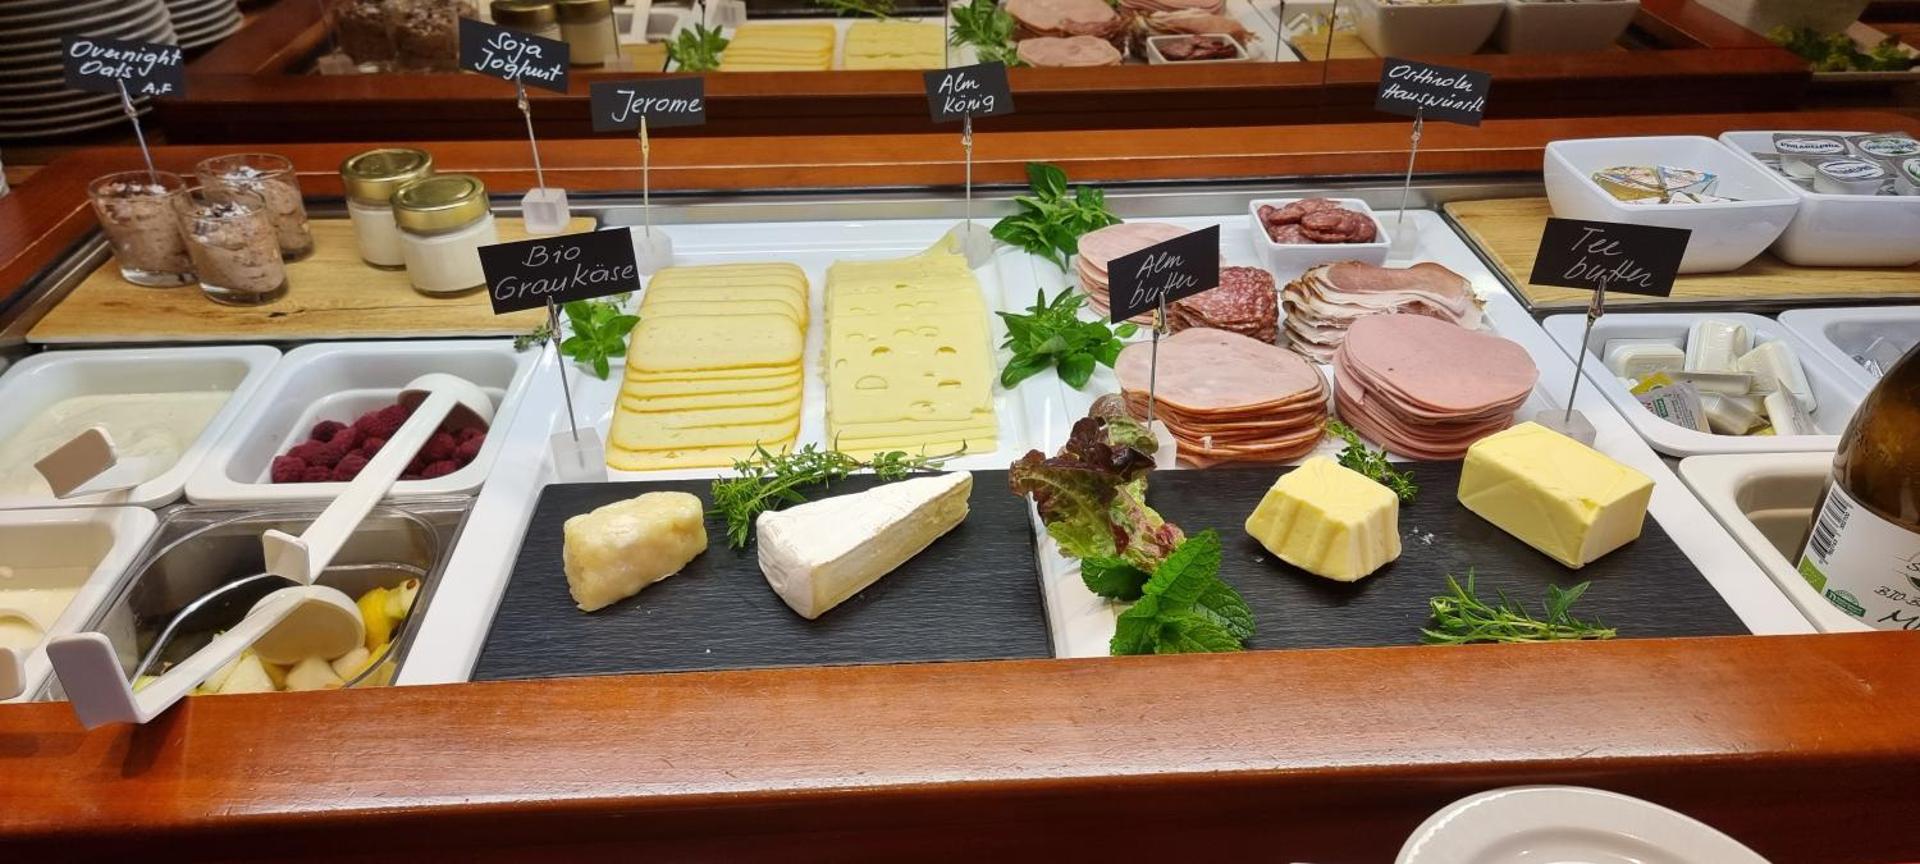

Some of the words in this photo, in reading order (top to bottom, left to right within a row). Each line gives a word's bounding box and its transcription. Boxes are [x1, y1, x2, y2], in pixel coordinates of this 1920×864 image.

[70, 41, 182, 76] Overnight
[488, 32, 542, 63] Soja
[79, 60, 134, 79] Oats
[474, 48, 563, 81] Joghurt
[1388, 65, 1473, 92] Osttiroler
[938, 72, 980, 94] Alm
[611, 89, 702, 123] Jerome
[521, 245, 581, 267] Bio
[1571, 227, 1622, 256] Tee
[1135, 251, 1185, 279] Alm
[1563, 256, 1653, 288] butter
[494, 263, 635, 301] Graukäse
[1128, 272, 1199, 309] butter
